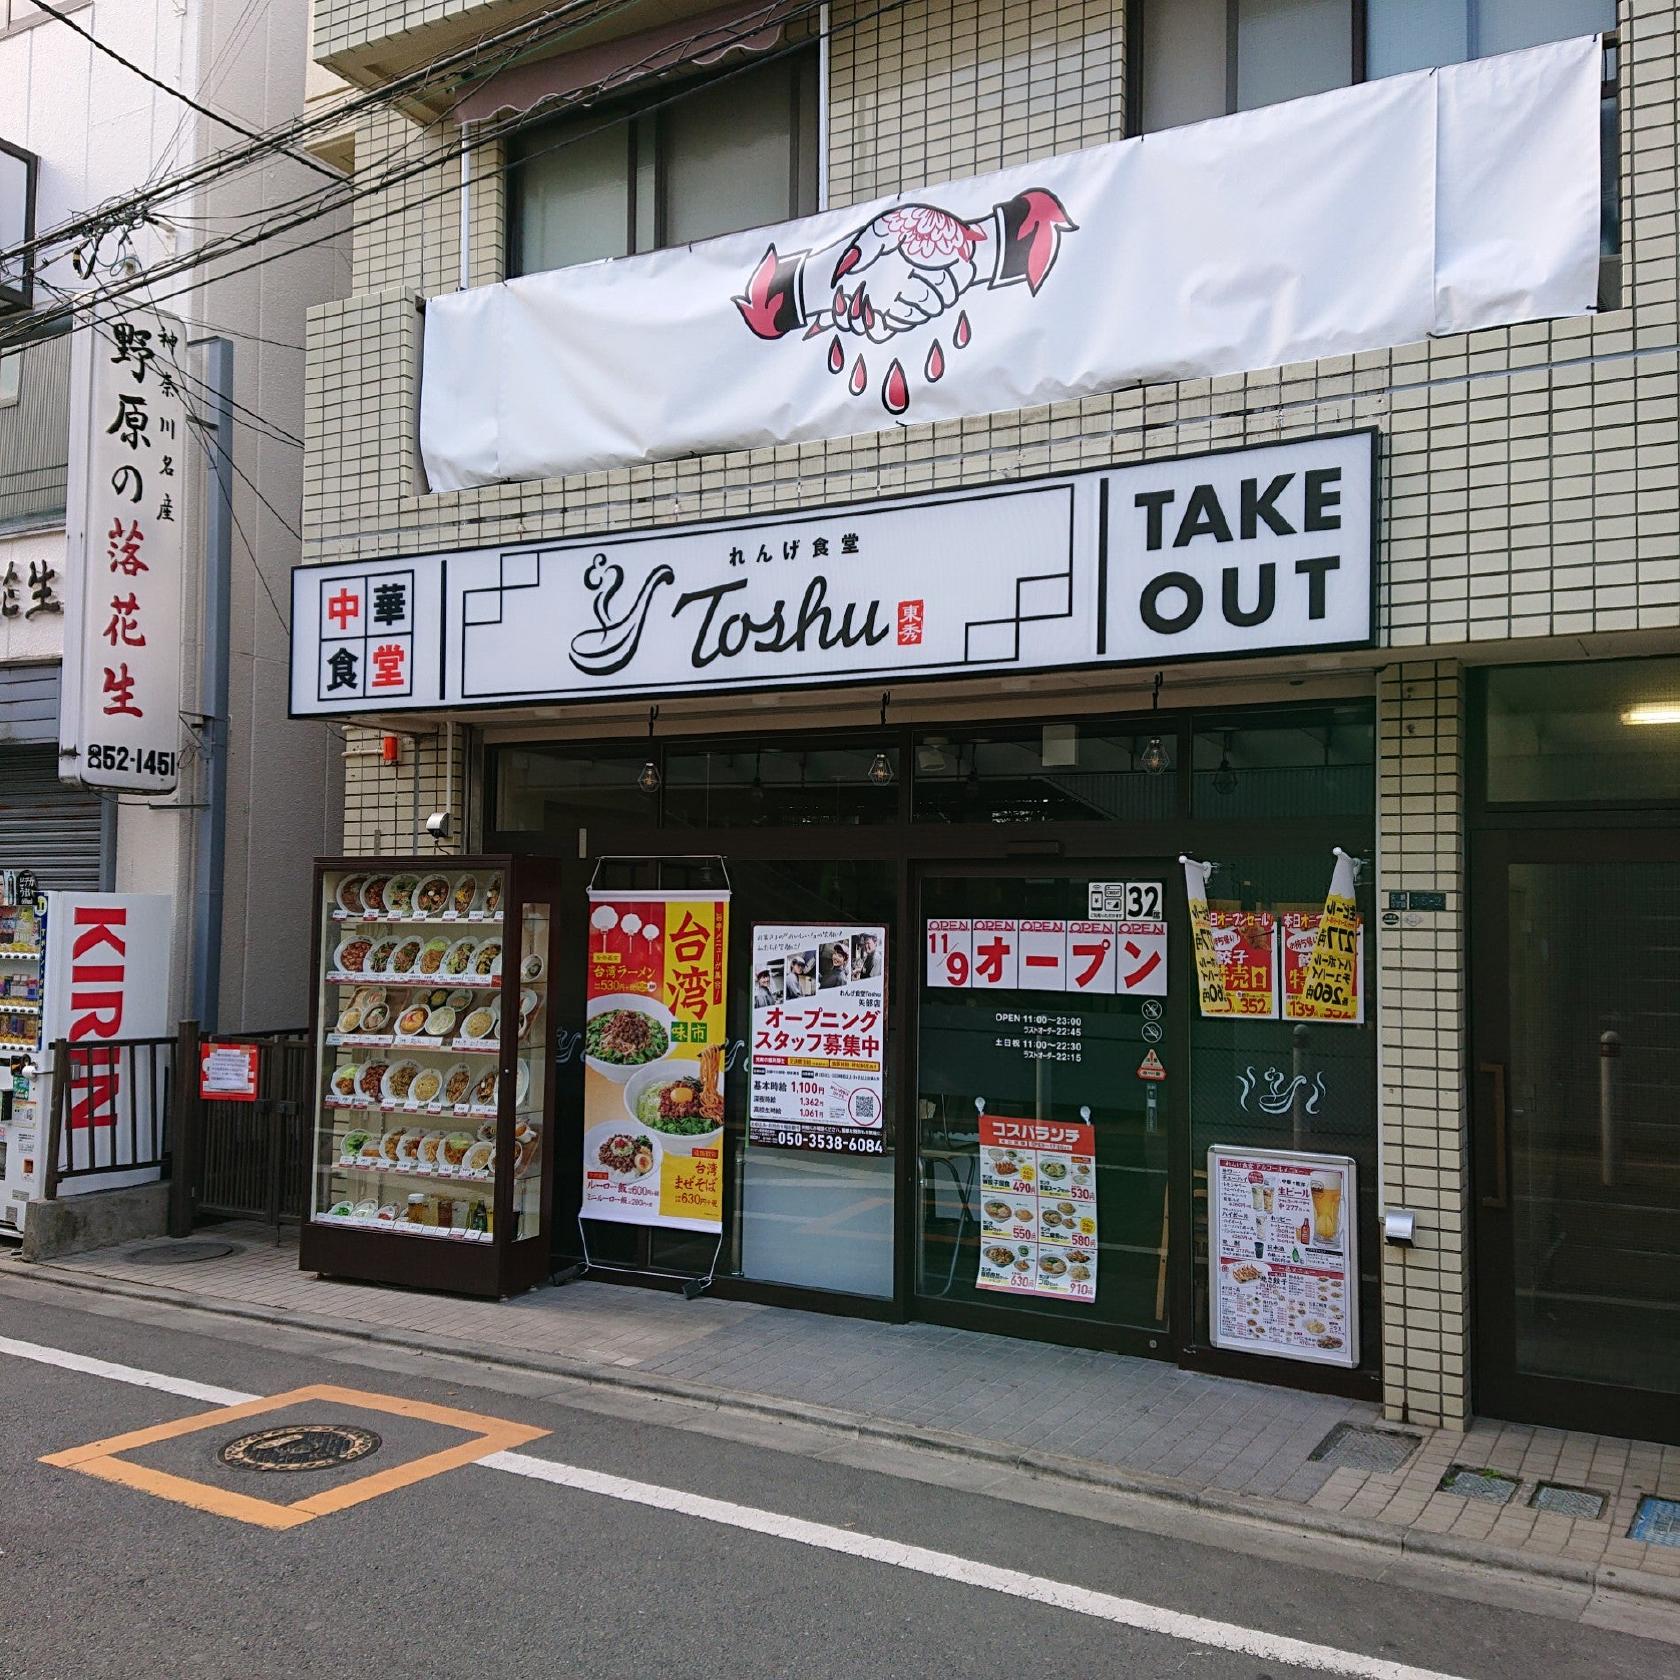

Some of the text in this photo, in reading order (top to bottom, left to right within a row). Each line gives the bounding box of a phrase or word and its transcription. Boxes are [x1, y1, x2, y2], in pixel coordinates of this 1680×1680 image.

[157, 326, 179, 523] 神奈川名産
[103, 322, 156, 719] 野原の落花生
[1134, 467, 1342, 551] TAKE
[729, 532, 860, 566] れんげ食堂
[1139, 555, 1341, 635] OUT
[328, 584, 406, 630] 中華
[671, 575, 890, 668] Toshu
[899, 604, 922, 644] 東秀
[326, 644, 405, 692] 食堂
[1127, 886, 1159, 918] 32
[928, 920, 1166, 935] OPEN OPEN OPEN OPEN OPEN
[593, 965, 657, 979] 台湾ラーメン
[666, 910, 713, 1021] 台湾
[975, 936, 1162, 989] オープン
[66, 907, 127, 1130] KIRIN
[766, 1007, 880, 1033] オープニング
[995, 1013, 1021, 1022] OPEN
[755, 1030, 880, 1058] スタッフ募集中
[995, 1039, 1020, 1048] 土日祝
[753, 1081, 788, 1093] 基本時給
[791, 1081, 825, 1095] 1,100円
[778, 1132, 883, 1153] 050-3538-6084
[695, 1161, 719, 1176] 台湾
[674, 1175, 718, 1193] まぜそば
[1012, 1181, 1036, 1195] 490円
[1071, 1188, 1095, 1201] 530円
[1278, 1186, 1310, 1199] 生ビール
[1012, 1227, 1037, 1241] 550円
[1071, 1234, 1096, 1249] 580円
[1010, 1275, 1035, 1288] 630円
[1070, 1282, 1094, 1295] 910円
